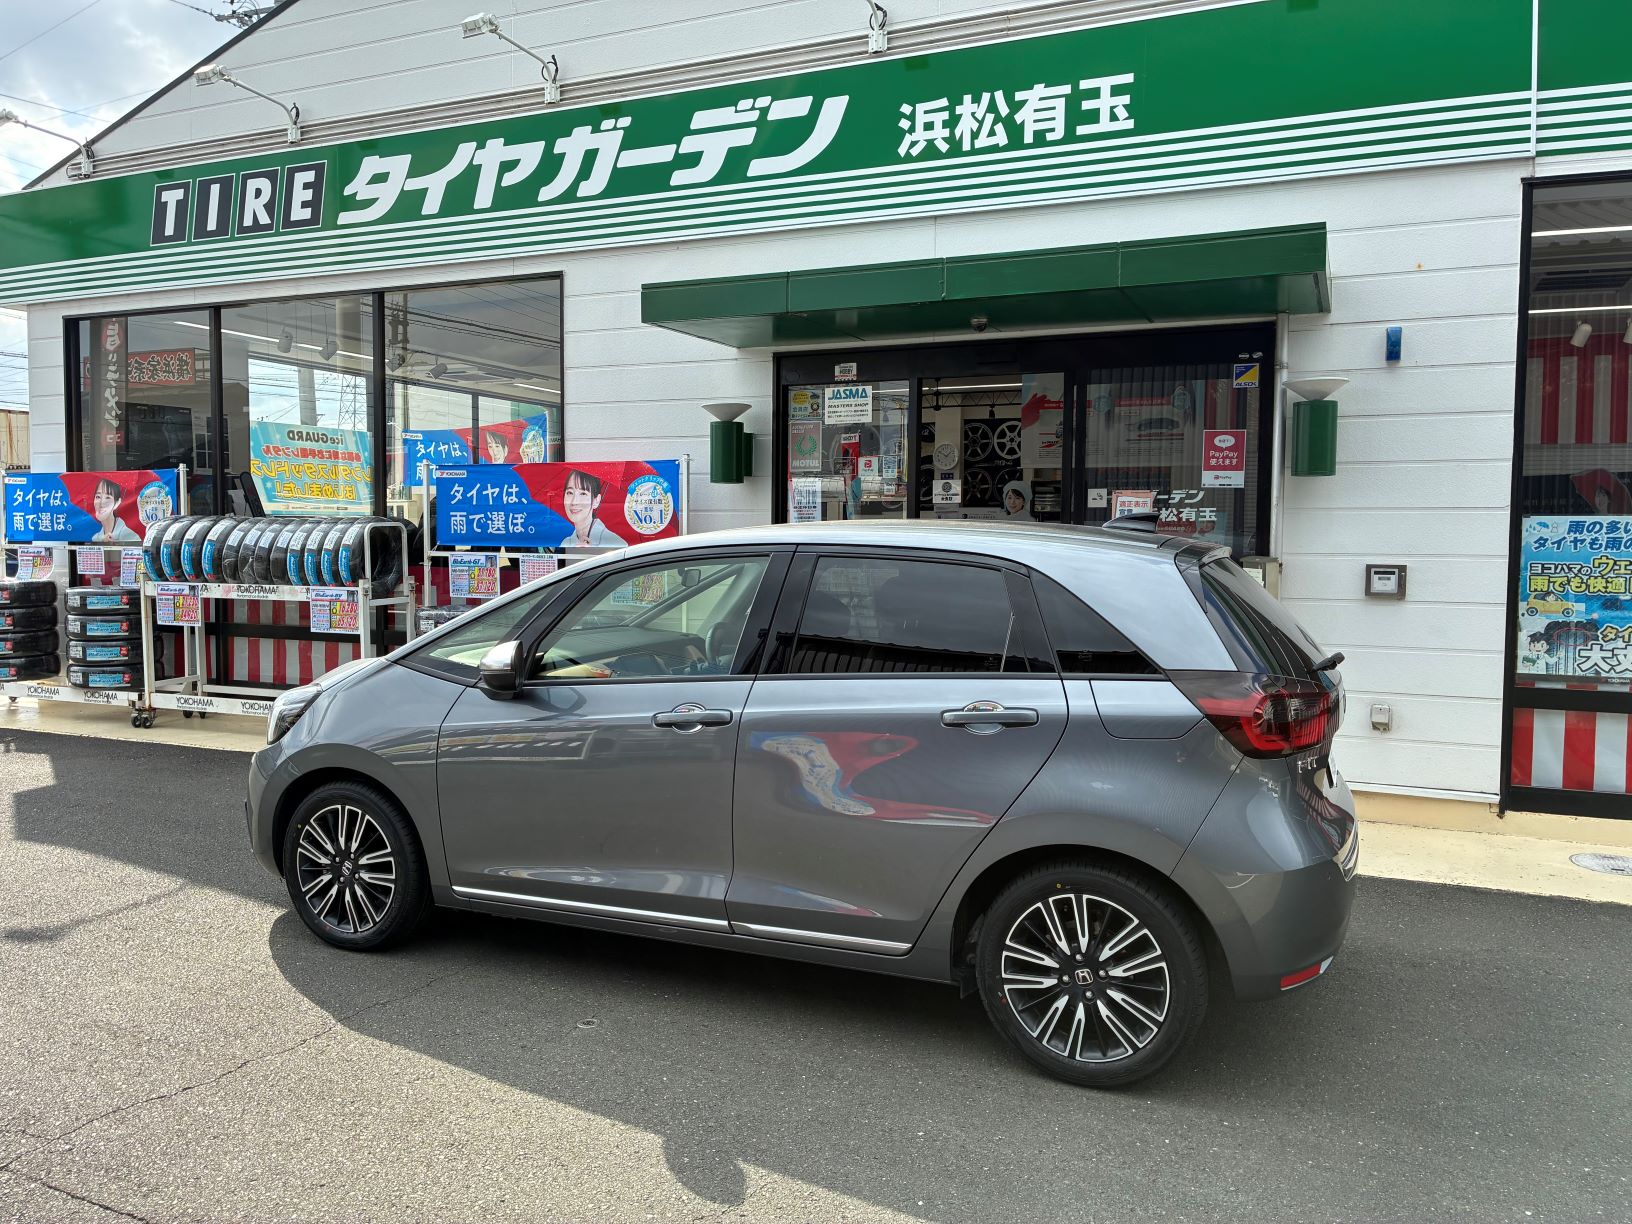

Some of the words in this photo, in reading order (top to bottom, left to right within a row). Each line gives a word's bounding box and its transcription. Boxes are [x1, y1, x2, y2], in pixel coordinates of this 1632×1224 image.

[160, 170, 316, 237] TIRE
[336, 94, 850, 225] タイヤガーデン
[898, 73, 1136, 158] 浜松有玉
[828, 388, 868, 400] JASMA
[1209, 450, 1239, 459] PayPay
[13, 488, 68, 507] タイヤは、
[450, 483, 528, 505] タイヤは、
[13, 512, 73, 531] 雨で選ぼ。
[632, 509, 665, 525] No.1
[1151, 507, 1217, 522] 松有玉
[449, 511, 535, 534] 雨で選ぼ。
[1529, 576, 1632, 593] 雨でも快適
[27, 685, 60, 696] YOKOHAMA
[84, 690, 119, 701] YOKOHAMA
[176, 696, 214, 707] YOKOHAMA
[240, 701, 274, 712] YOKOHA
